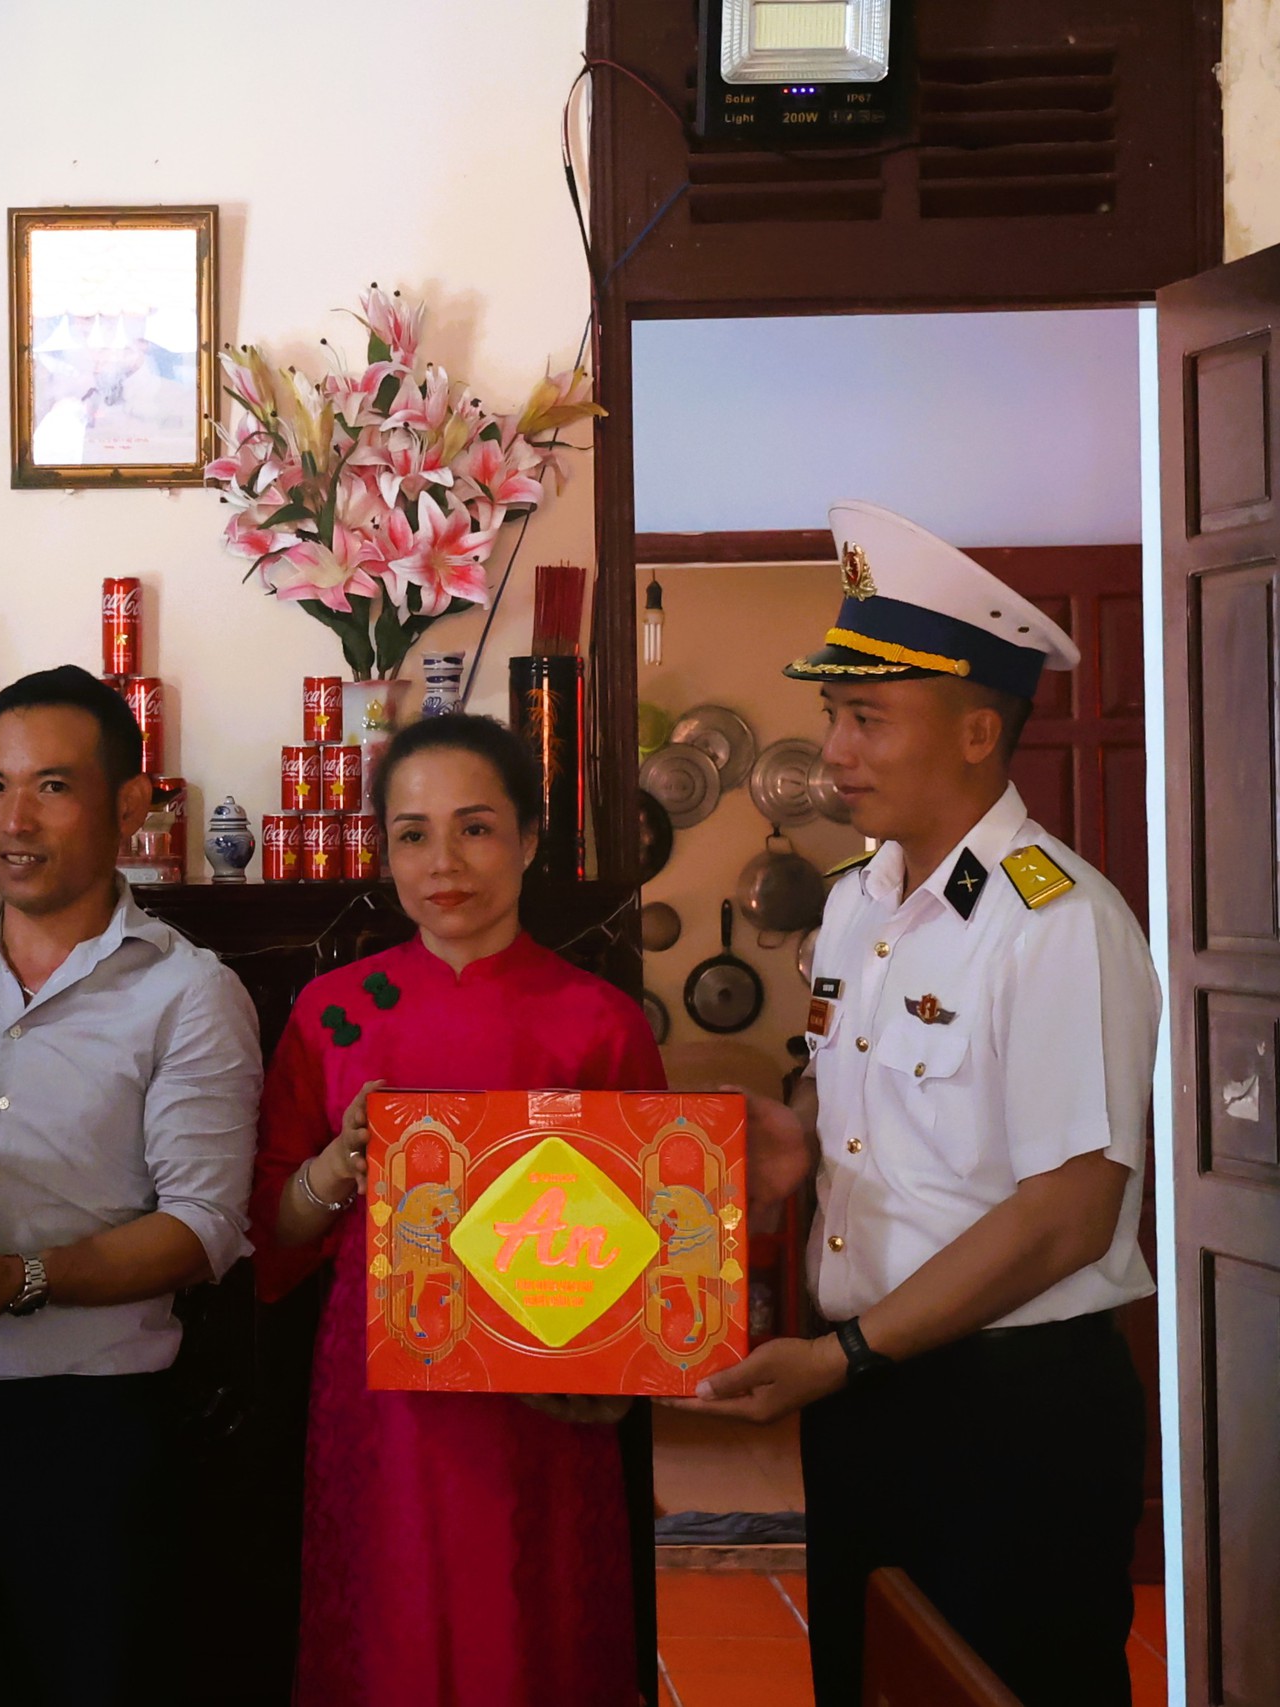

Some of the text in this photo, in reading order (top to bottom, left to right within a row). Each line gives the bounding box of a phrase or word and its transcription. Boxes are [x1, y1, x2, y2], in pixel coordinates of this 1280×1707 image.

[725, 93, 755, 104] Solar
[846, 93, 872, 103] IP67
[724, 113, 755, 125] Light
[783, 112, 819, 123] 200W
[493, 1186, 620, 1273] An
